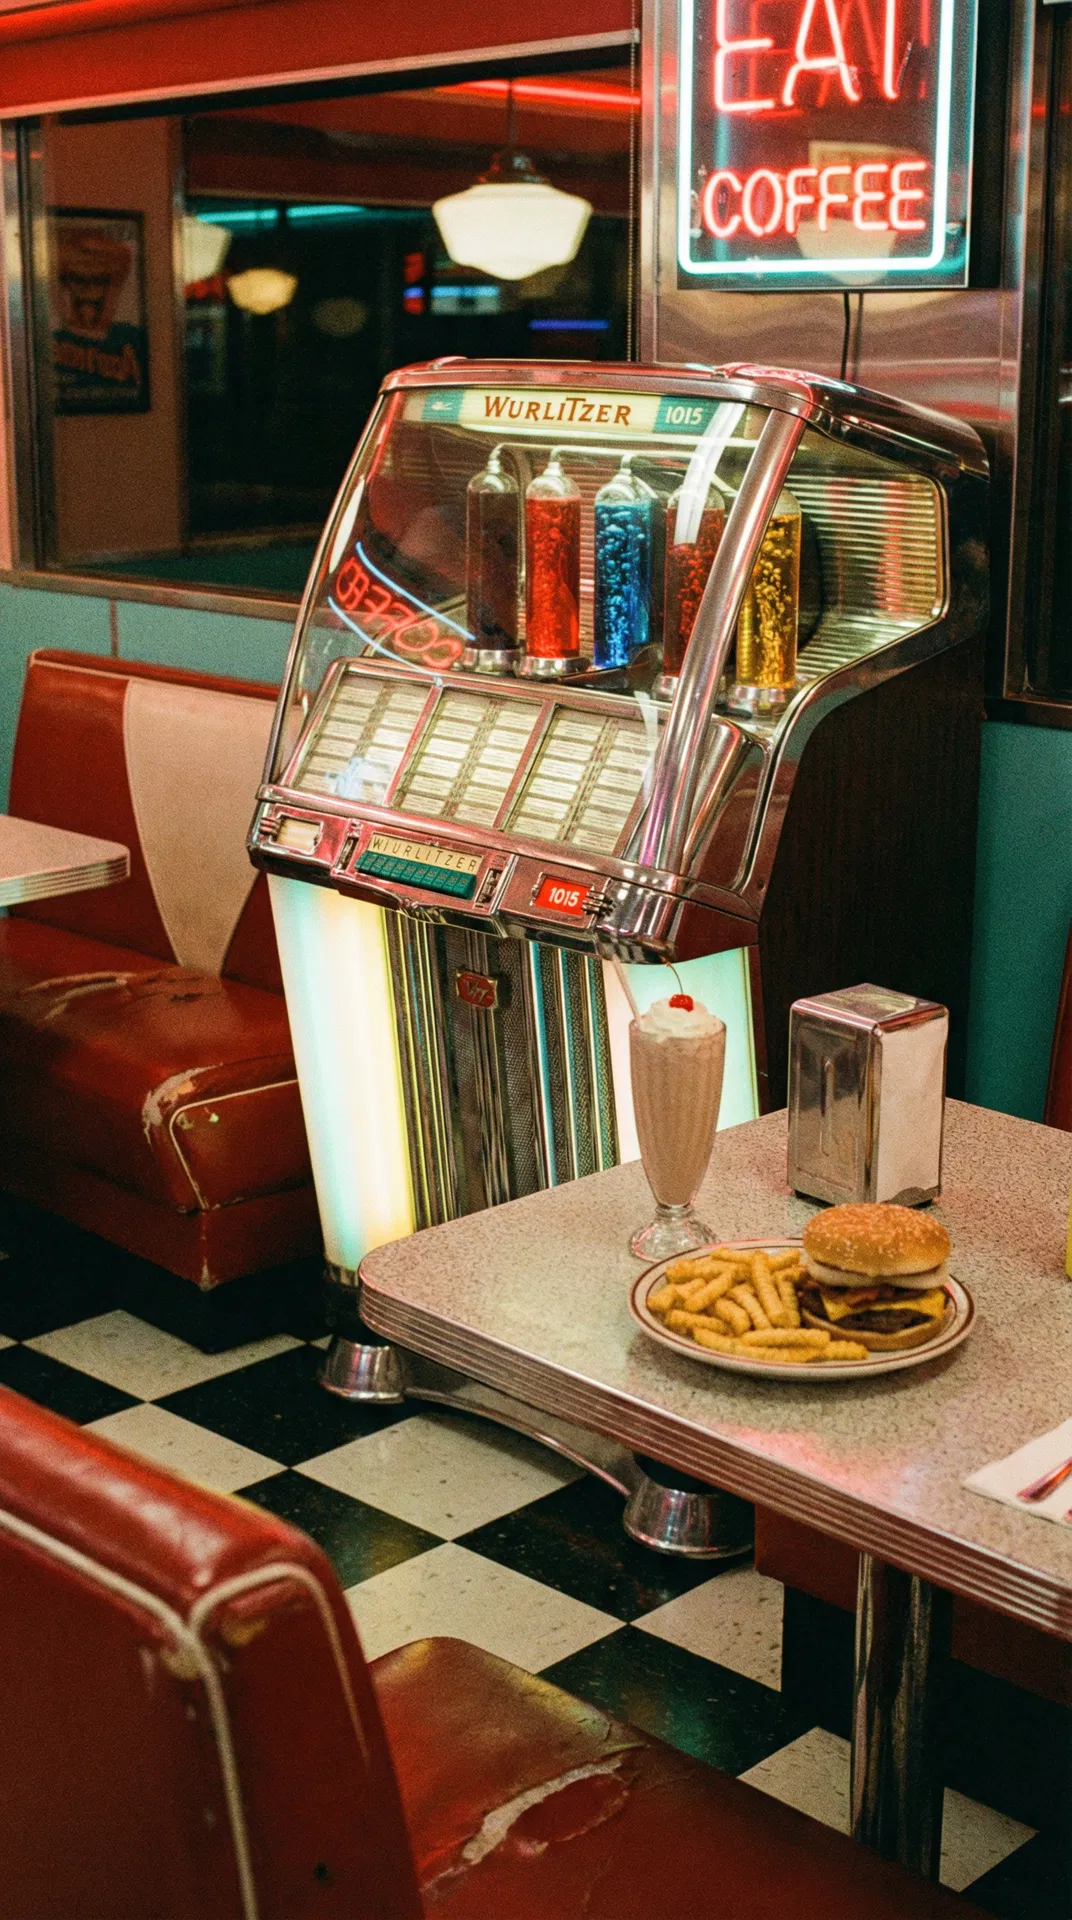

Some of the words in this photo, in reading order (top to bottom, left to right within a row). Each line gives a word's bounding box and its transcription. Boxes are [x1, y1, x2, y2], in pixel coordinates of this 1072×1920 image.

[704, 161, 928, 238] COFFEE
[485, 396, 631, 425] WURLITZER
[665, 406, 704, 425] 1015
[549, 887, 580, 907] 1015
